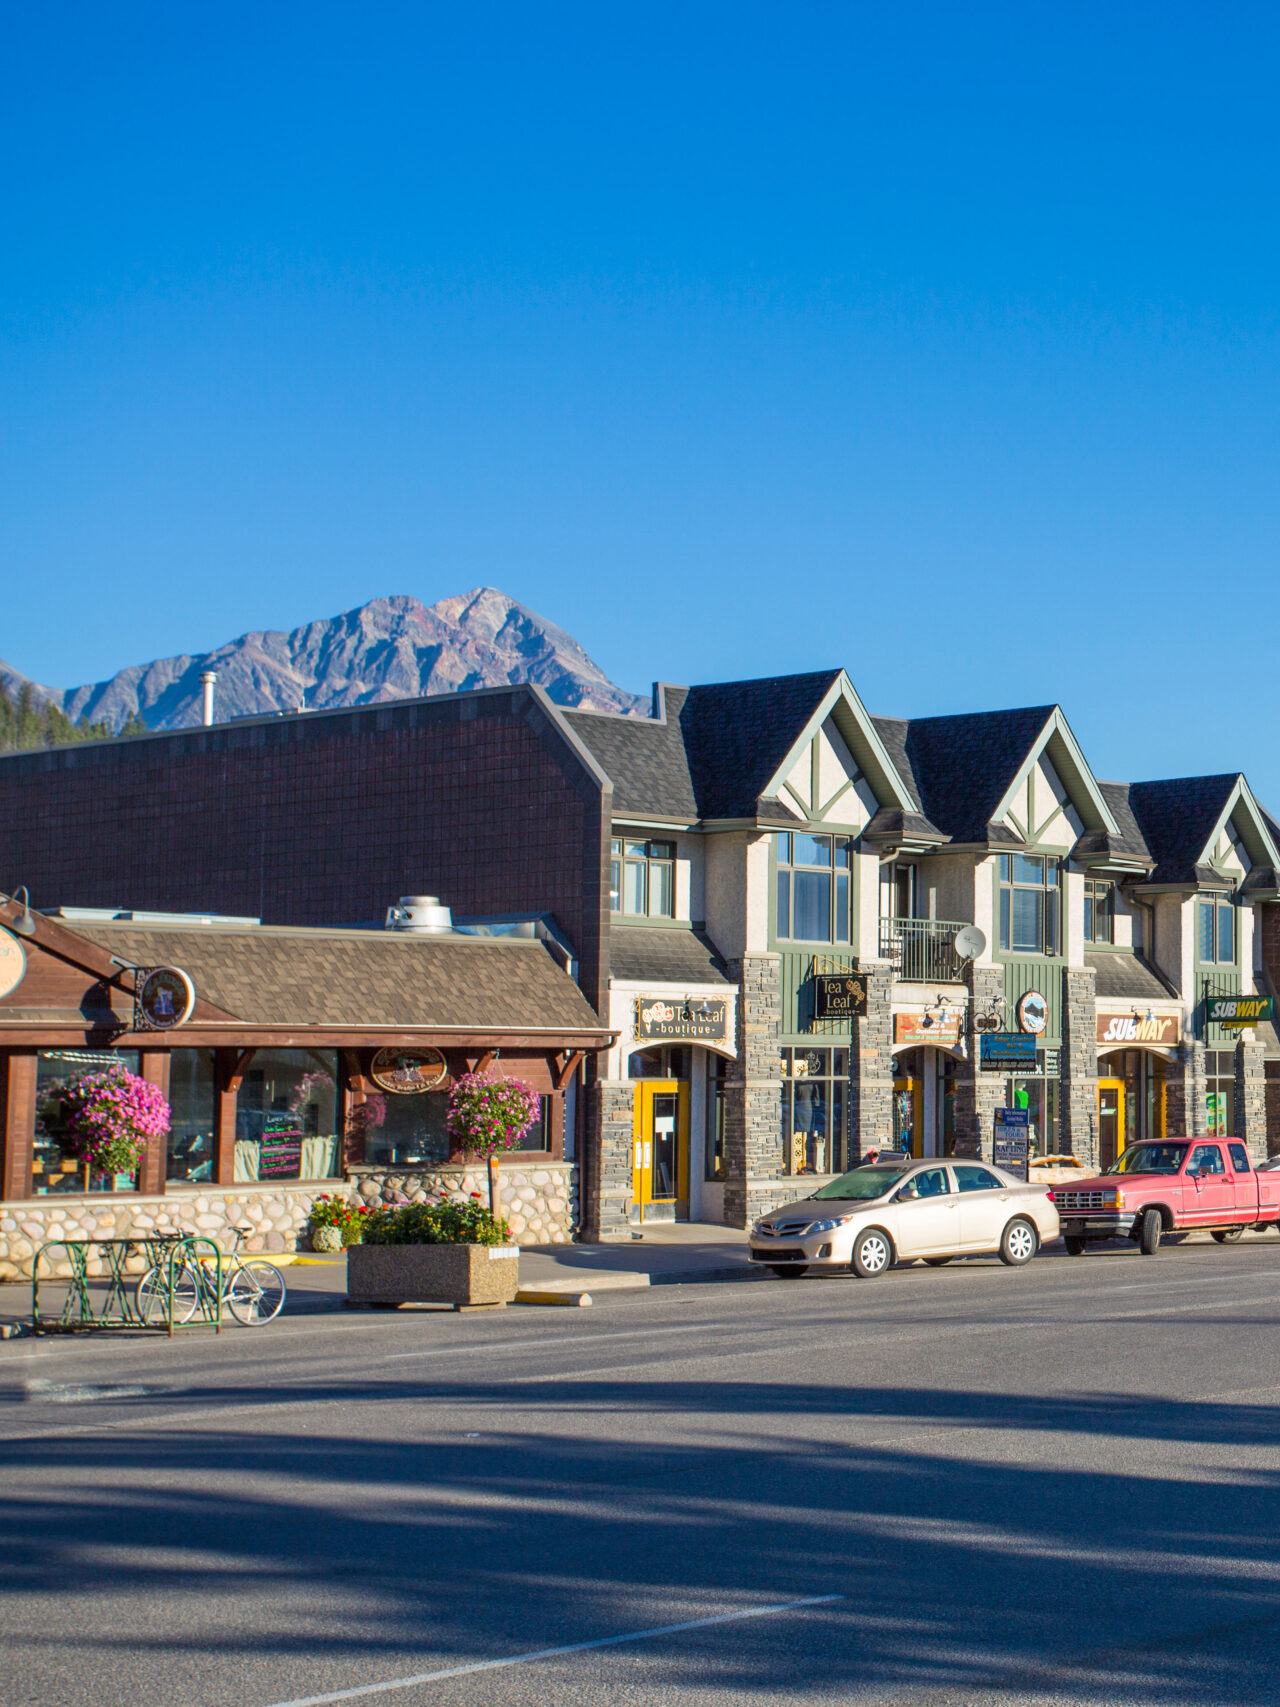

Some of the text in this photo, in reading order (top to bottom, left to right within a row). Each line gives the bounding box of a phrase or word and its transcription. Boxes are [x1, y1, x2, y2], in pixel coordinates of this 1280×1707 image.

[822, 979, 842, 993] Tea
[827, 992, 851, 1008] Leaf
[1211, 1000, 1268, 1018] SUBWAY
[1103, 1018, 1172, 1041] SUBWAY
[995, 1145, 1027, 1153] RAFTING
